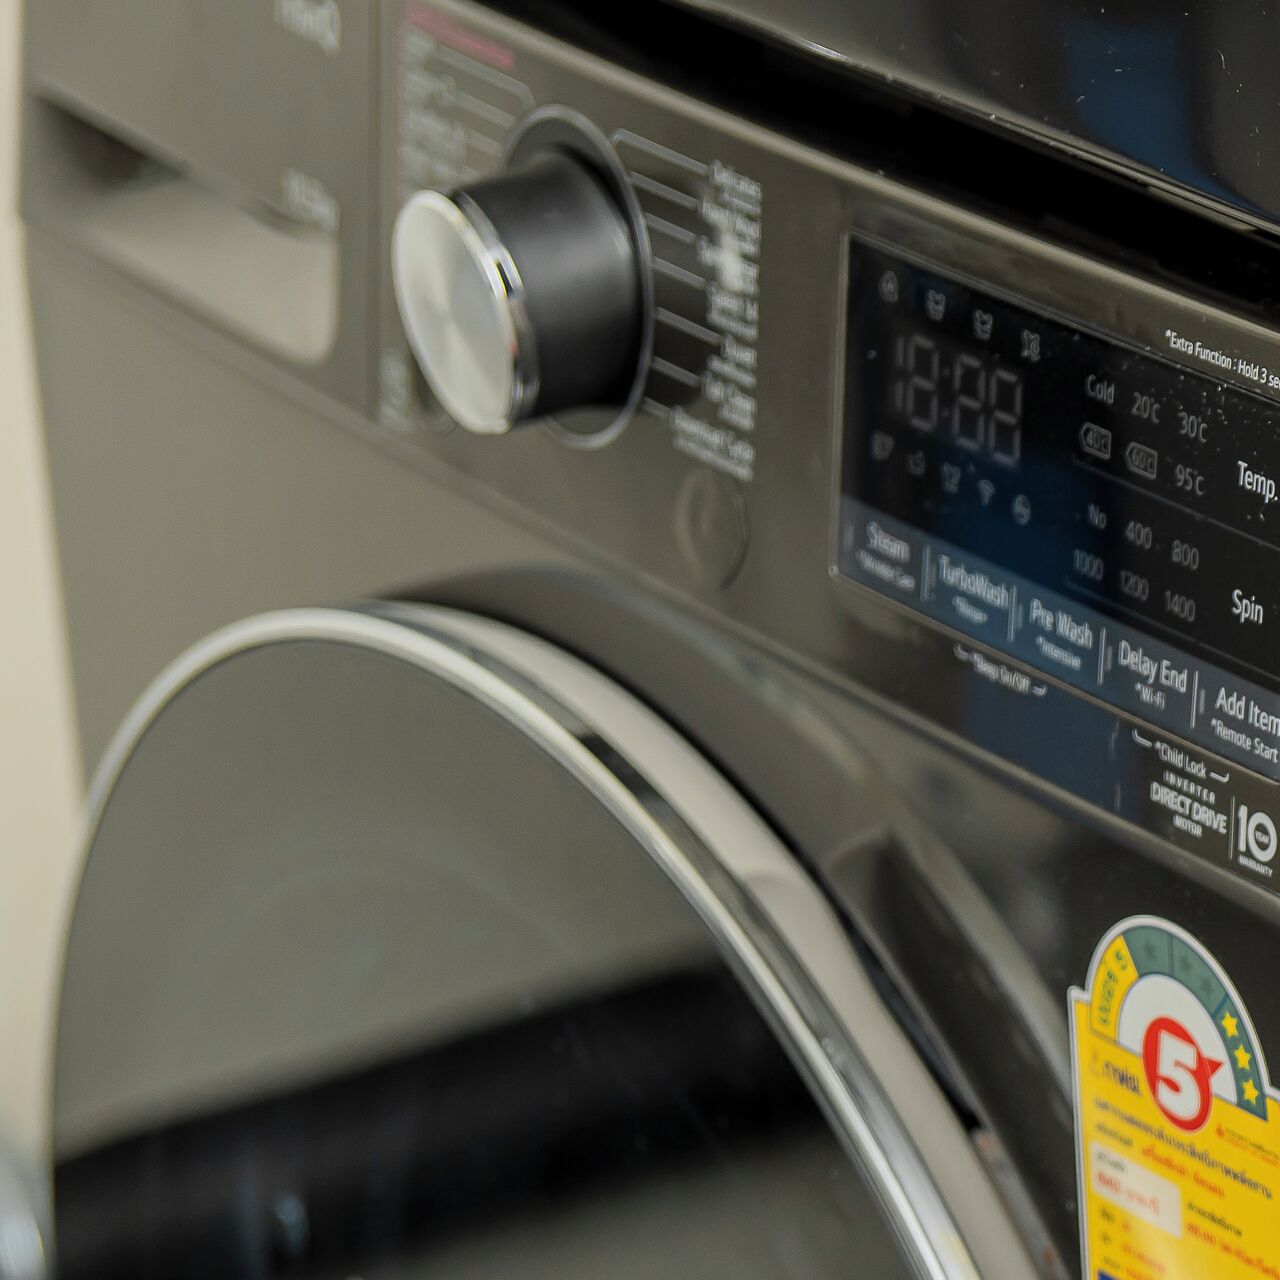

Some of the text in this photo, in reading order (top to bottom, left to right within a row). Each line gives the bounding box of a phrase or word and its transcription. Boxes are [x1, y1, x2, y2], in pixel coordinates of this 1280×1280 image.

[1195, 341, 1232, 370] Function
[1238, 359, 1259, 380] Hold
[1260, 367, 1268, 383] 3
[1087, 373, 1115, 404] Cold
[1238, 460, 1278, 503] Temp.
[1126, 520, 1152, 549] 400
[1171, 539, 1199, 571] 800
[1120, 569, 1149, 601] 1200
[1165, 589, 1196, 622] 1400
[1232, 588, 1263, 624] Spin
[1030, 598, 1093, 649] Pre Wash
[1119, 640, 1187, 693] Delay End
[1215, 687, 1245, 720] Add
[1185, 755, 1206, 779] Lock
[1163, 770, 1216, 805] INVERTER
[1150, 781, 1228, 834] DIRECT DRIVE
[1238, 804, 1277, 862] 10
[1154, 1028, 1202, 1122] 5
